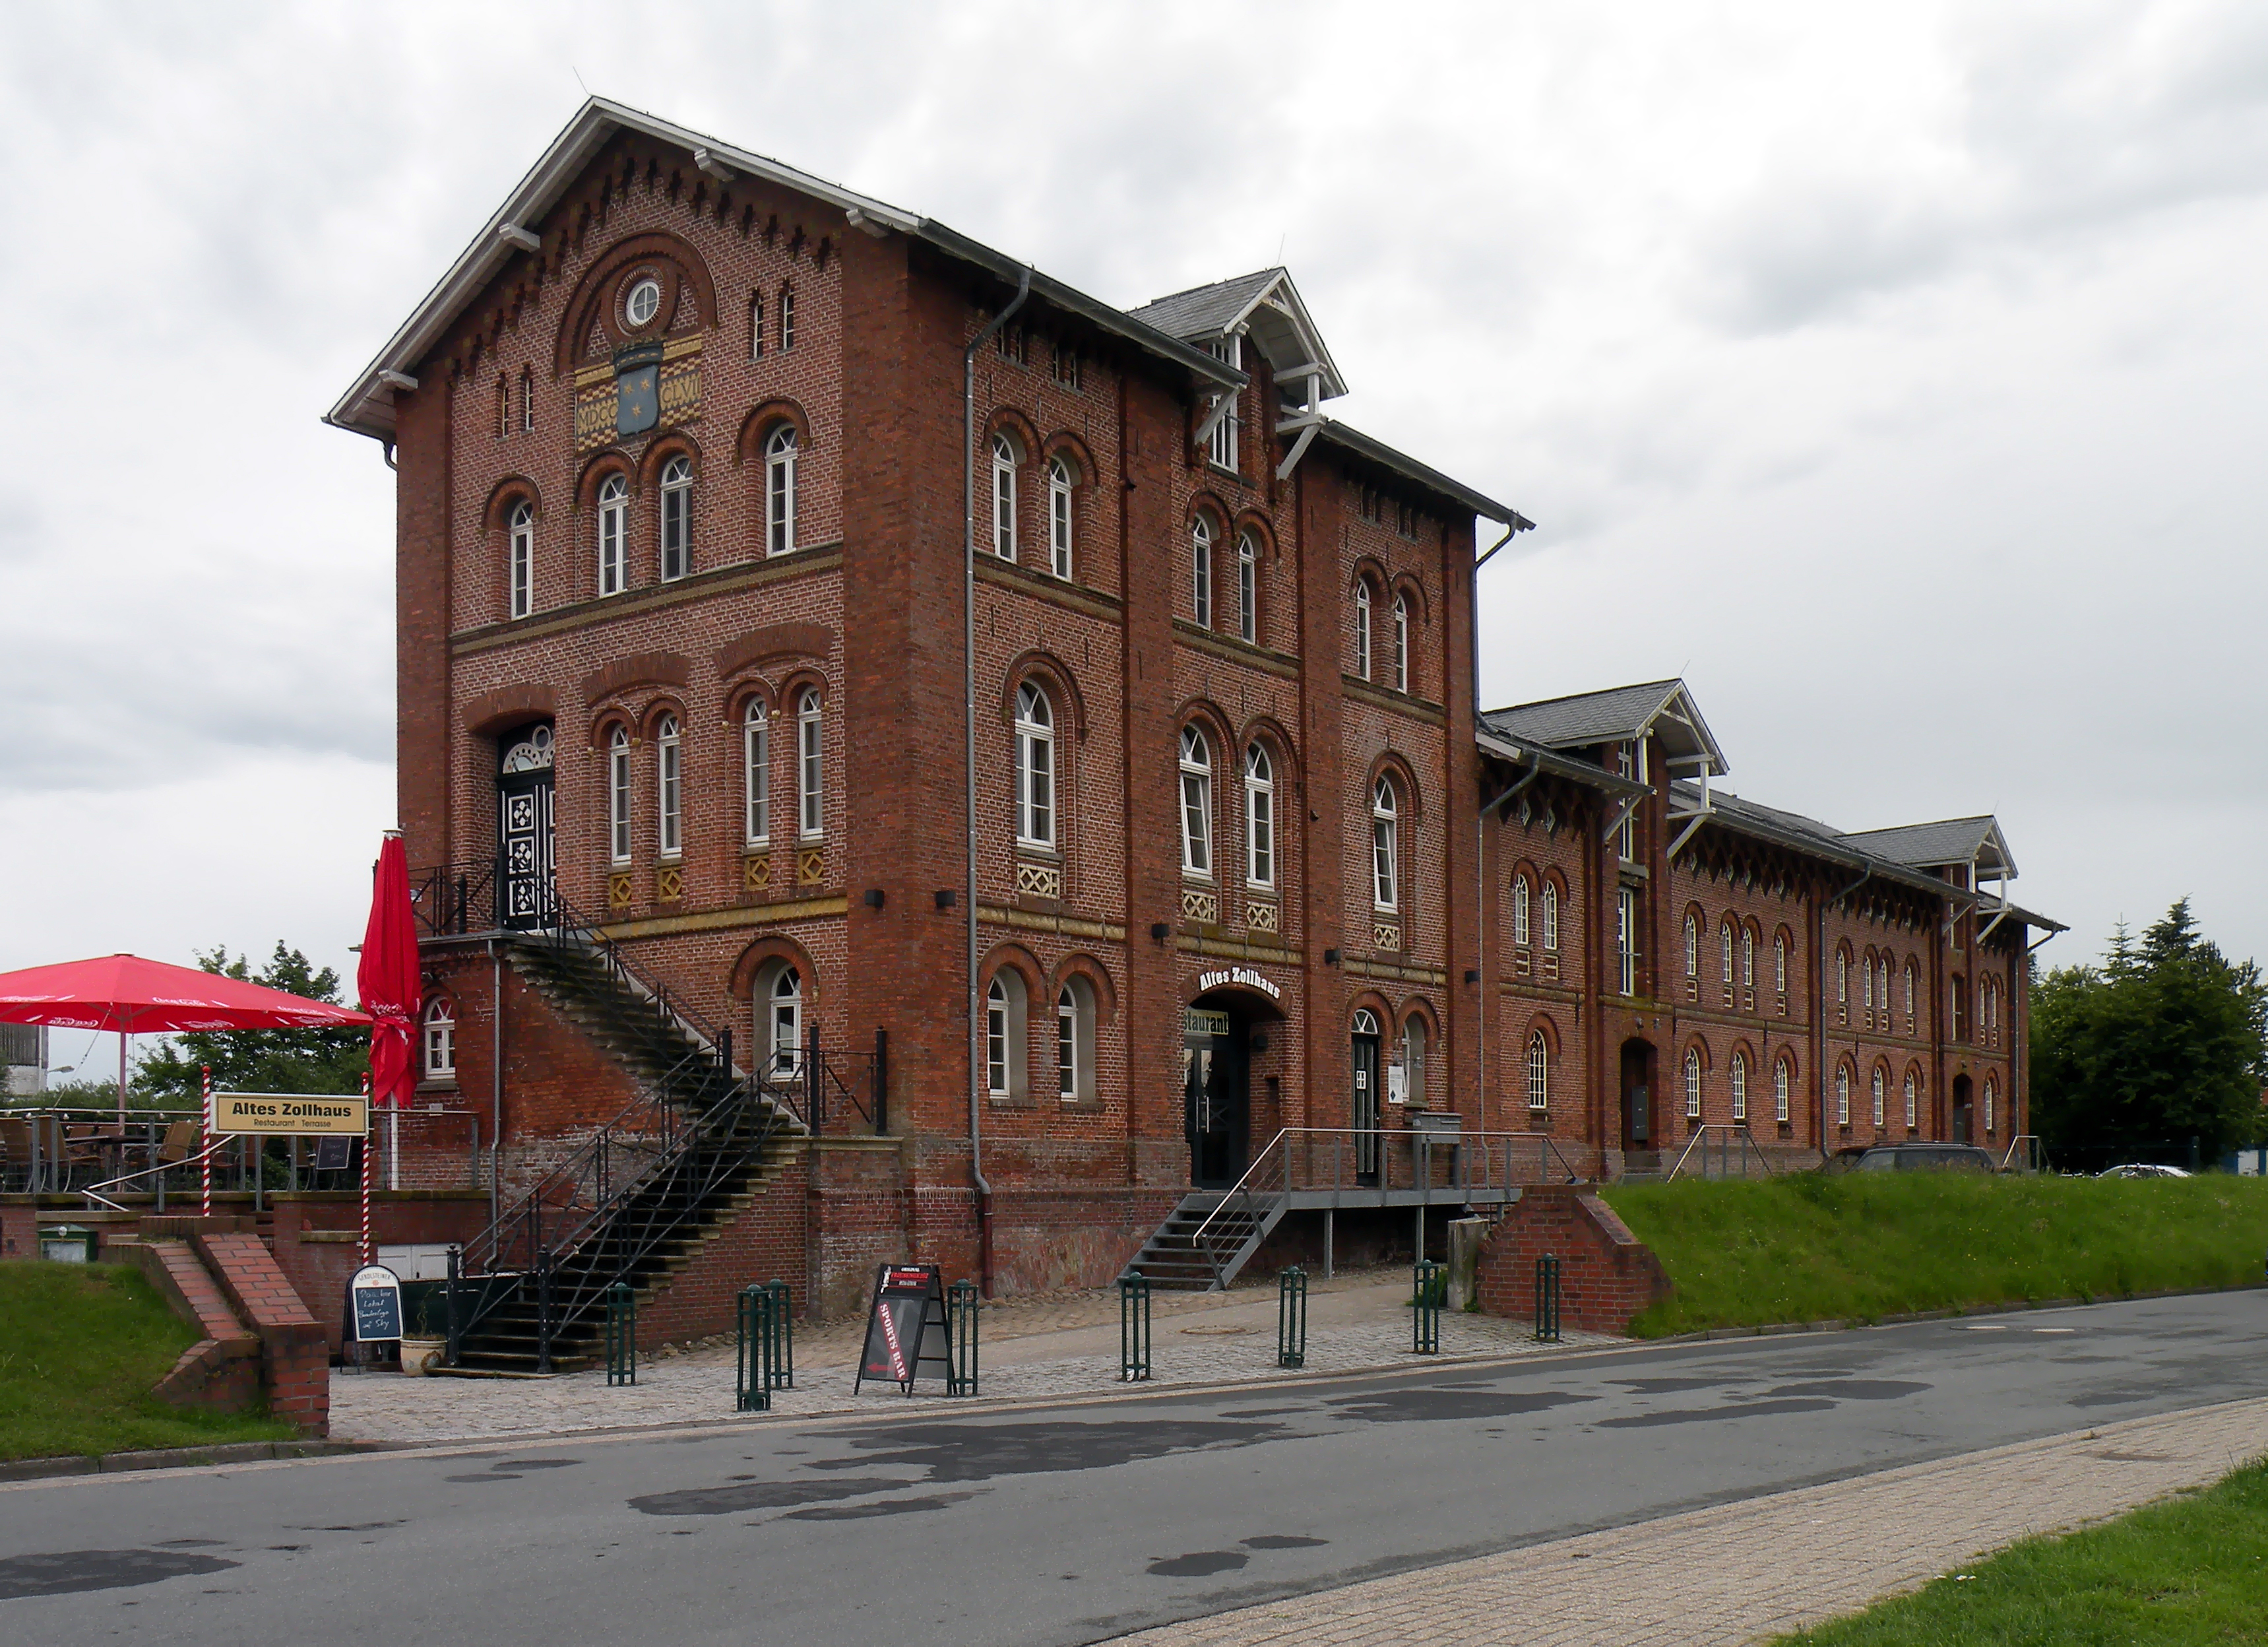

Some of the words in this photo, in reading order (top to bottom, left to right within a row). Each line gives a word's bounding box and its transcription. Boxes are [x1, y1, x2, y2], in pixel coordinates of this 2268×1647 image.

[1199, 970, 1229, 992] Altes
[1232, 966, 1281, 999] Zollhaus
[232, 1102, 276, 1116] Altes
[282, 1103, 352, 1117] Zollhaus
[254, 1118, 295, 1127] Restaurant
[301, 1119, 331, 1128] Terrasse
[880, 1304, 898, 1349] SPORTS
[893, 1351, 906, 1378] BAR
